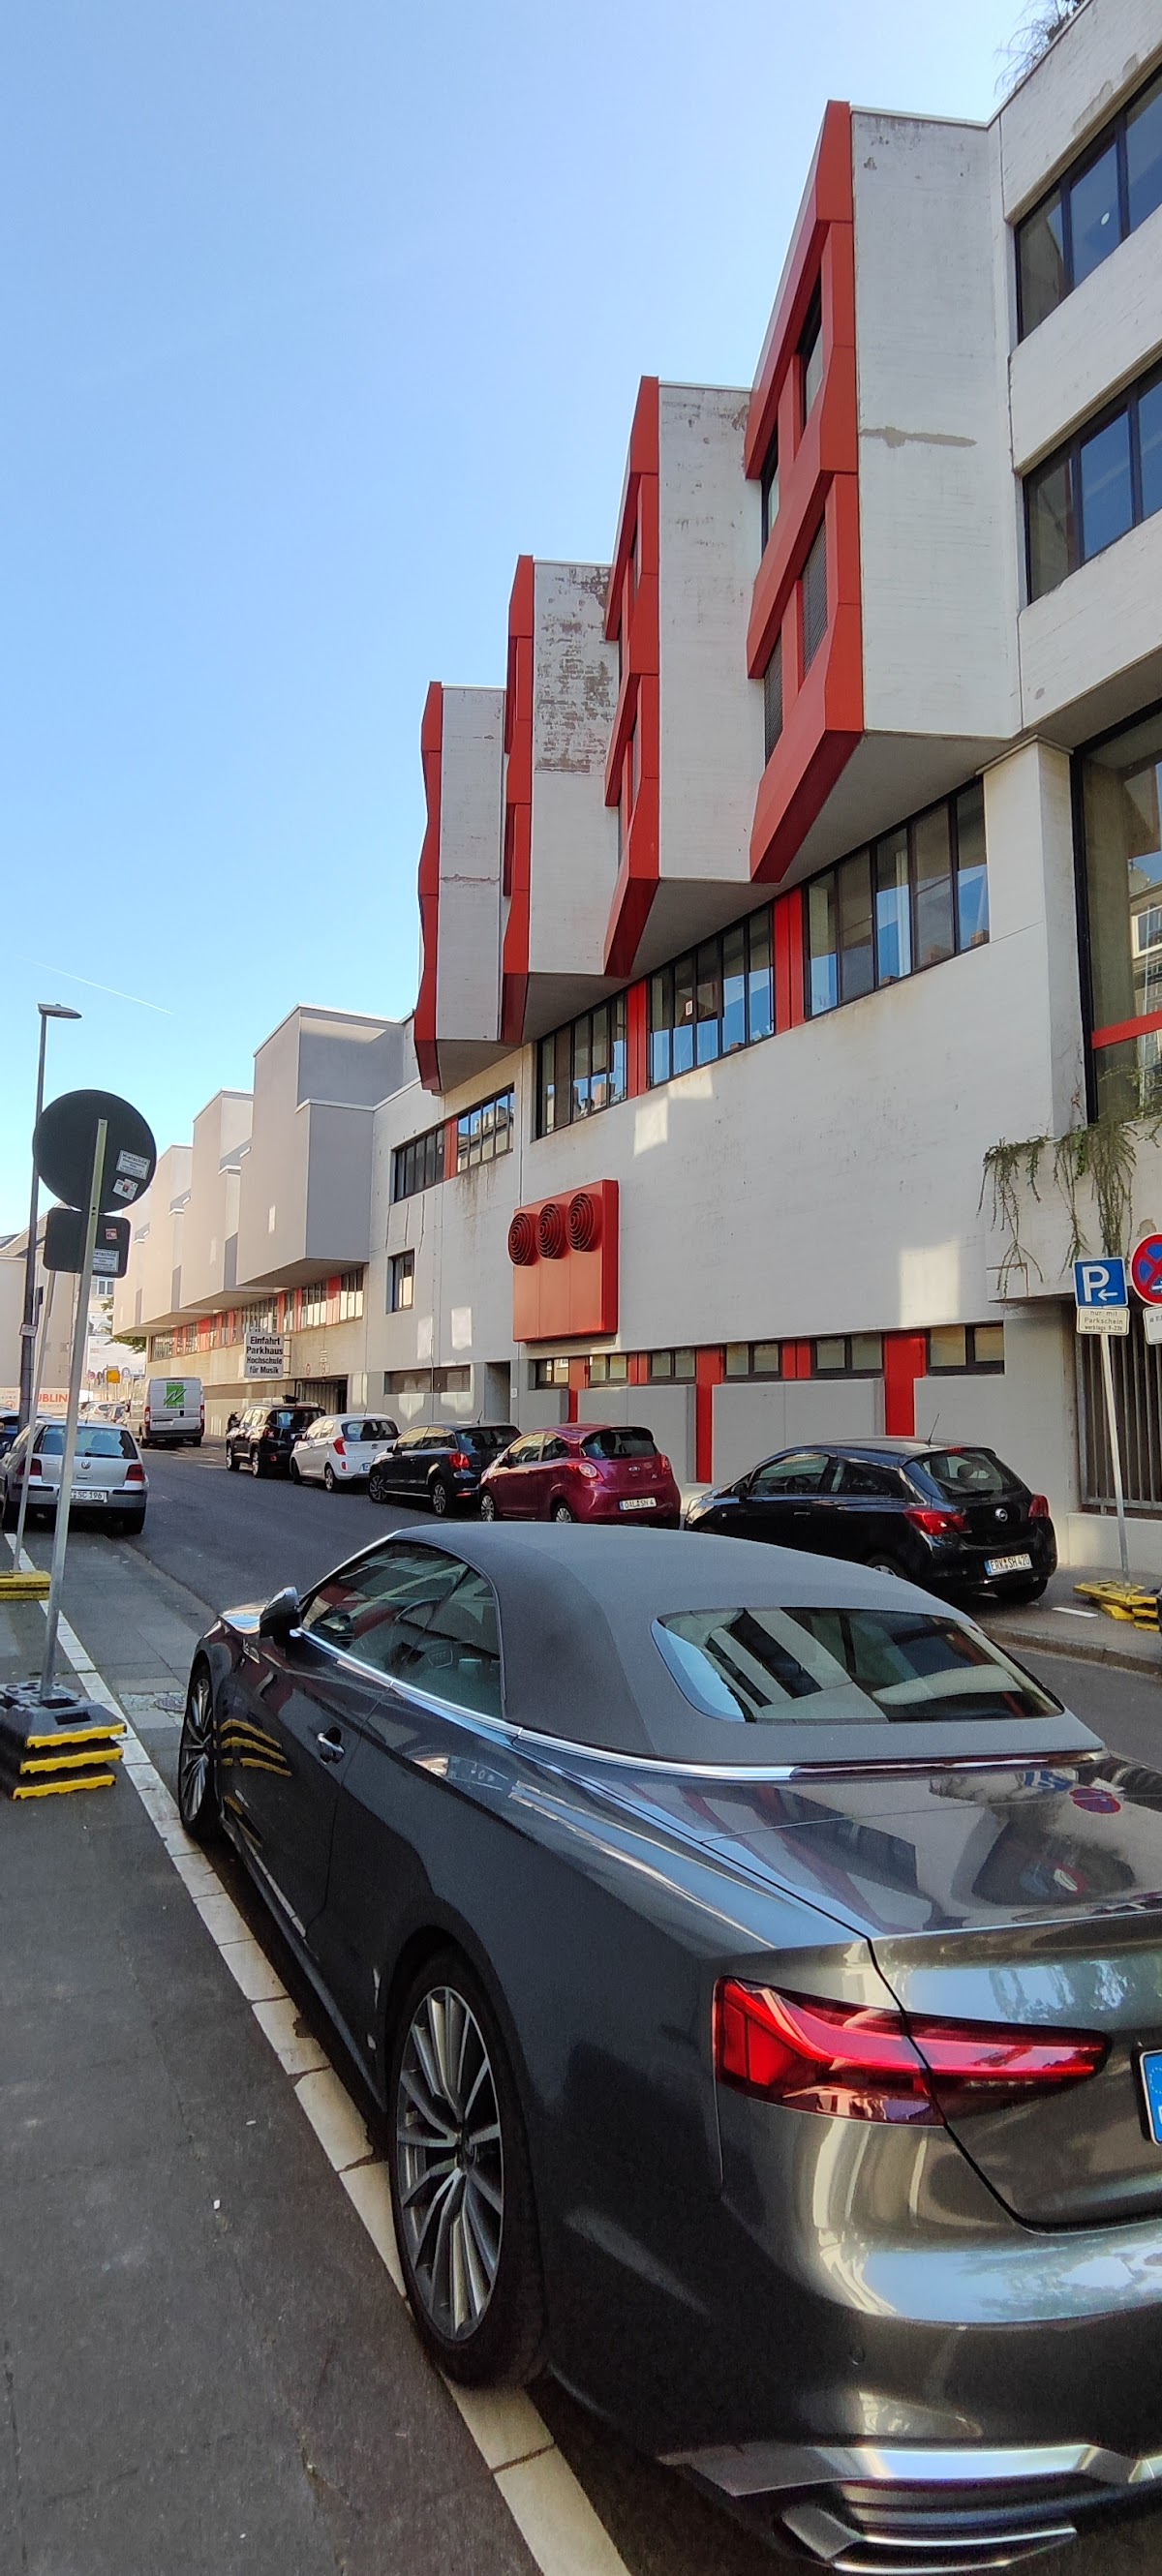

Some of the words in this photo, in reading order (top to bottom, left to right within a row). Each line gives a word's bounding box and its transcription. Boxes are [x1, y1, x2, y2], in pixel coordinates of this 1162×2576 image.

[1082, 1265, 1110, 1303] P
[1084, 1317, 1123, 1325] Parkschein
[250, 1336, 281, 1346] Einfahrt
[246, 1346, 284, 1355] Parkhaus
[246, 1356, 283, 1365] Hochschule
[260, 1366, 280, 1375] Musik
